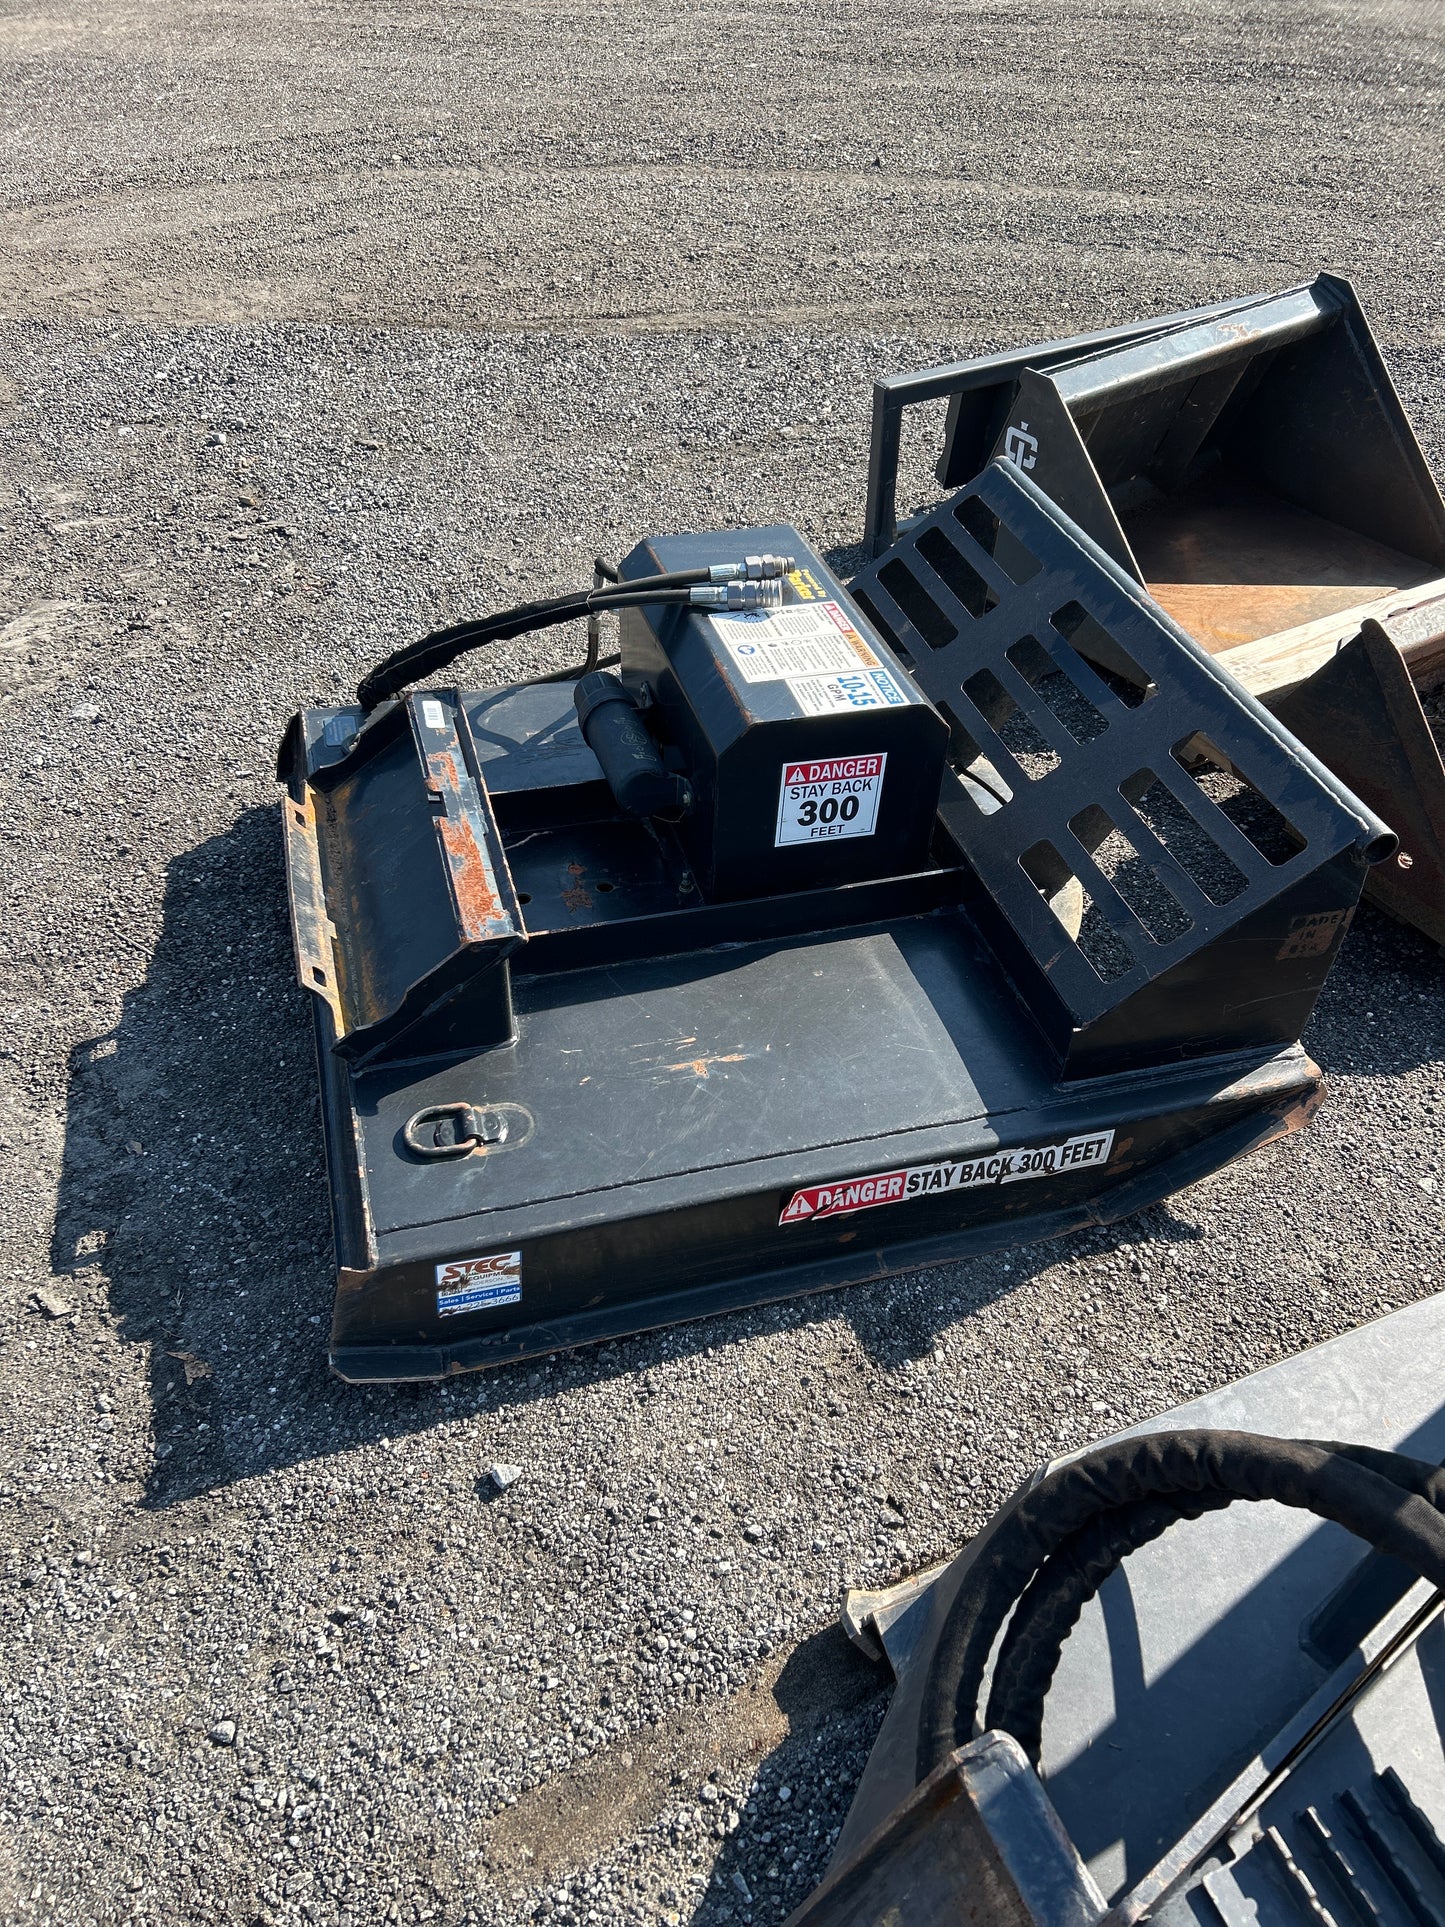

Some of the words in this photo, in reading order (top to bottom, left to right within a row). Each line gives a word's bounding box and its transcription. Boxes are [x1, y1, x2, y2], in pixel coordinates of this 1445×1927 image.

[828, 609, 851, 632] DANGER
[851, 640, 876, 666] WARNING
[827, 684, 848, 702] GPM
[836, 675, 877, 706] 10-15
[871, 672, 900, 702] NOTICE
[808, 758, 878, 781] DANGER
[790, 783, 828, 801] STAY
[831, 778, 873, 796] BACK
[797, 795, 860, 827] 300
[810, 824, 846, 838] FEET
[816, 1177, 903, 1210] DANGER
[906, 1166, 957, 1194] STAY
[959, 1155, 1015, 1184] BACK
[1017, 1149, 1056, 1174] 300
[1060, 1138, 1107, 1168] FEET
[441, 1255, 513, 1281] STEC
[439, 1297, 459, 1306] Sales
[465, 1290, 494, 1301] Service
[500, 1286, 521, 1294] Parts
